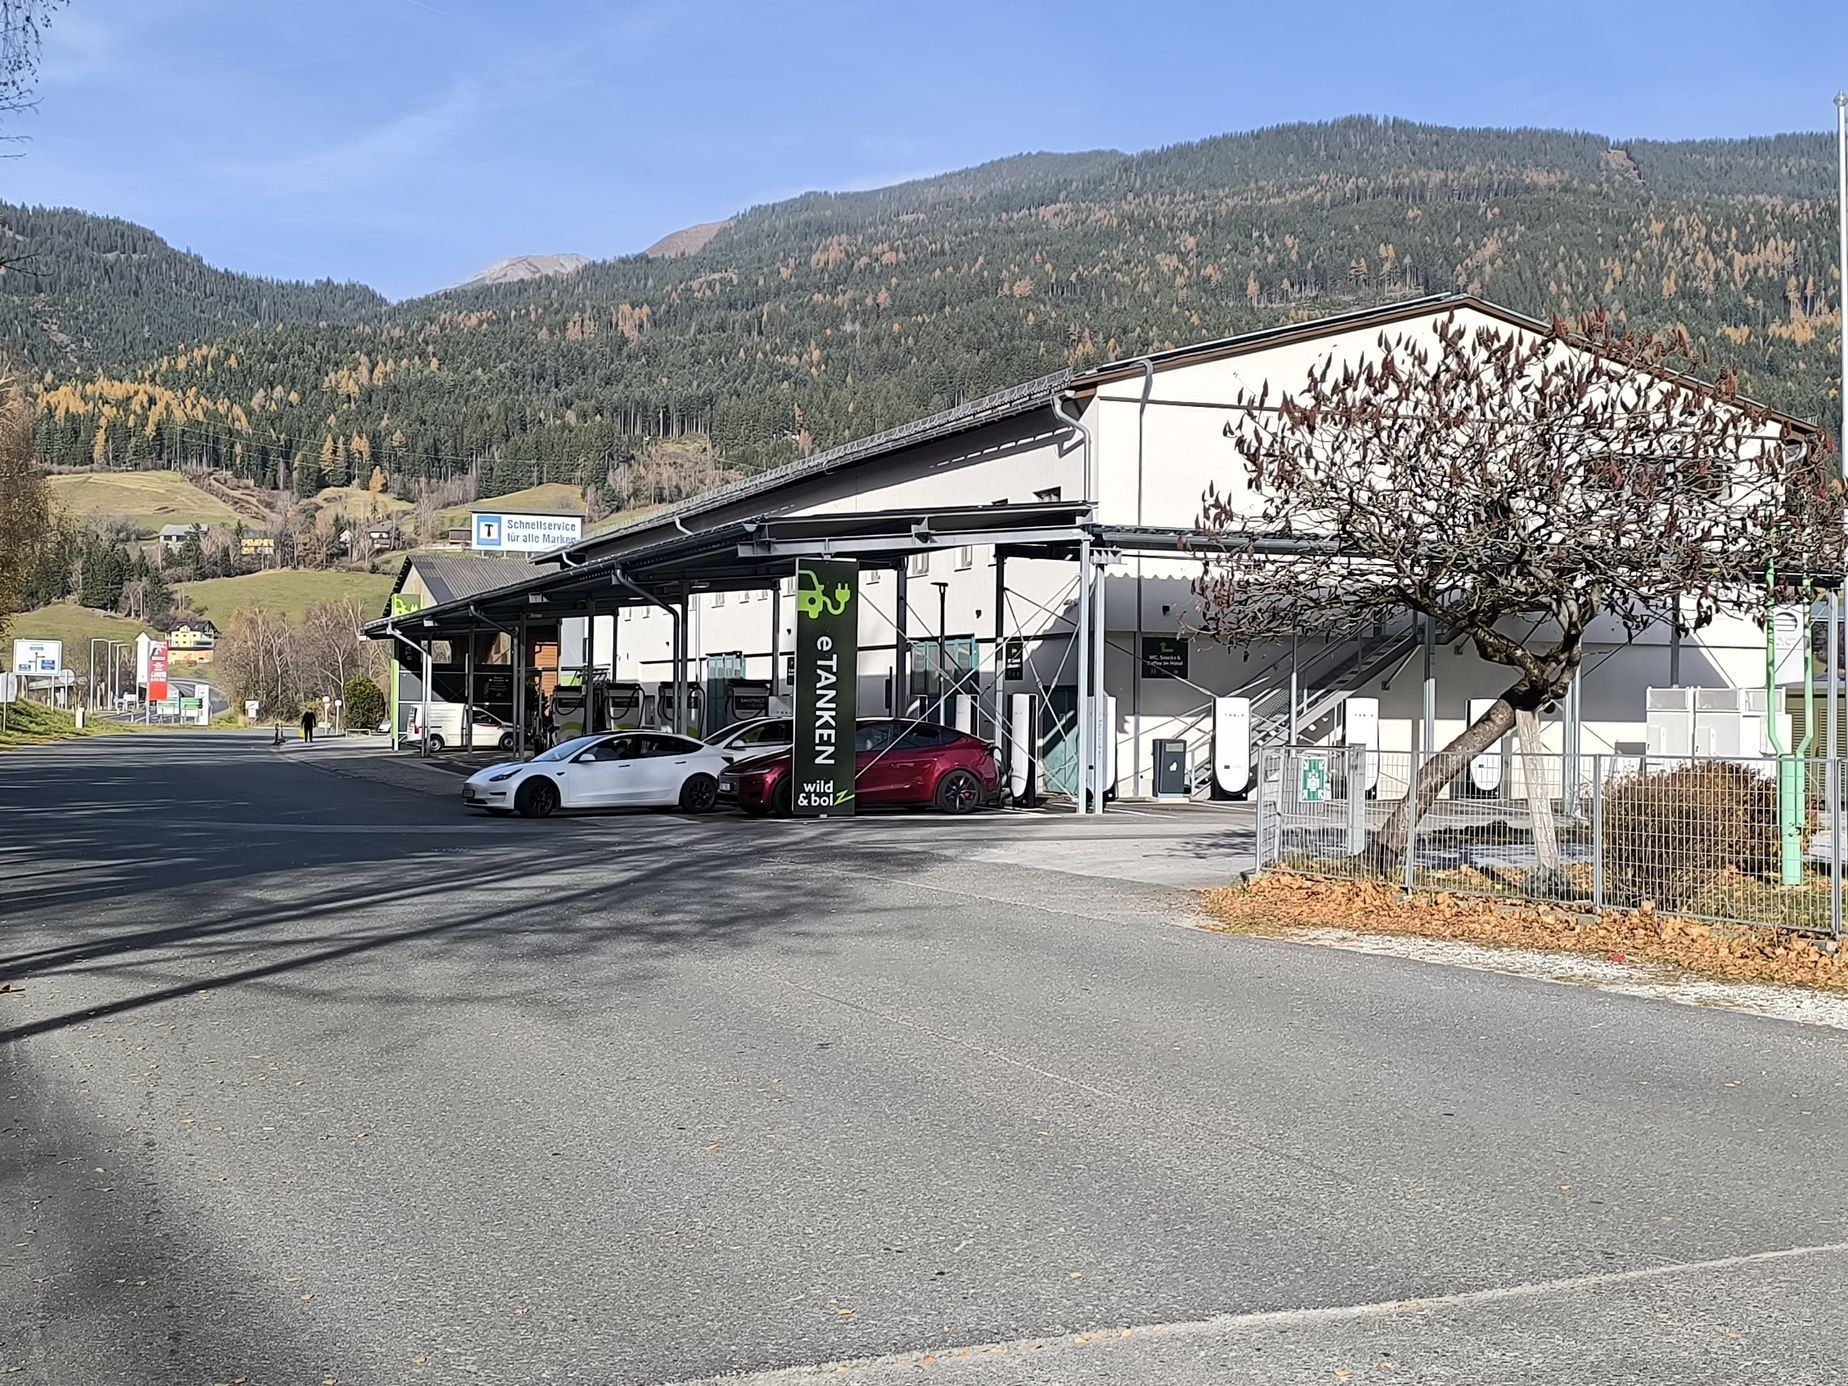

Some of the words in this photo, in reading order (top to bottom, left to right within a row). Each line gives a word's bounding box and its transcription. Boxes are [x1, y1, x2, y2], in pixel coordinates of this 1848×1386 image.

[507, 519, 576, 532] Schnellservice
[507, 532, 520, 543] für
[523, 534, 540, 543] alle
[542, 534, 577, 545] Marken
[803, 780, 833, 793] wild
[797, 793, 809, 806] &
